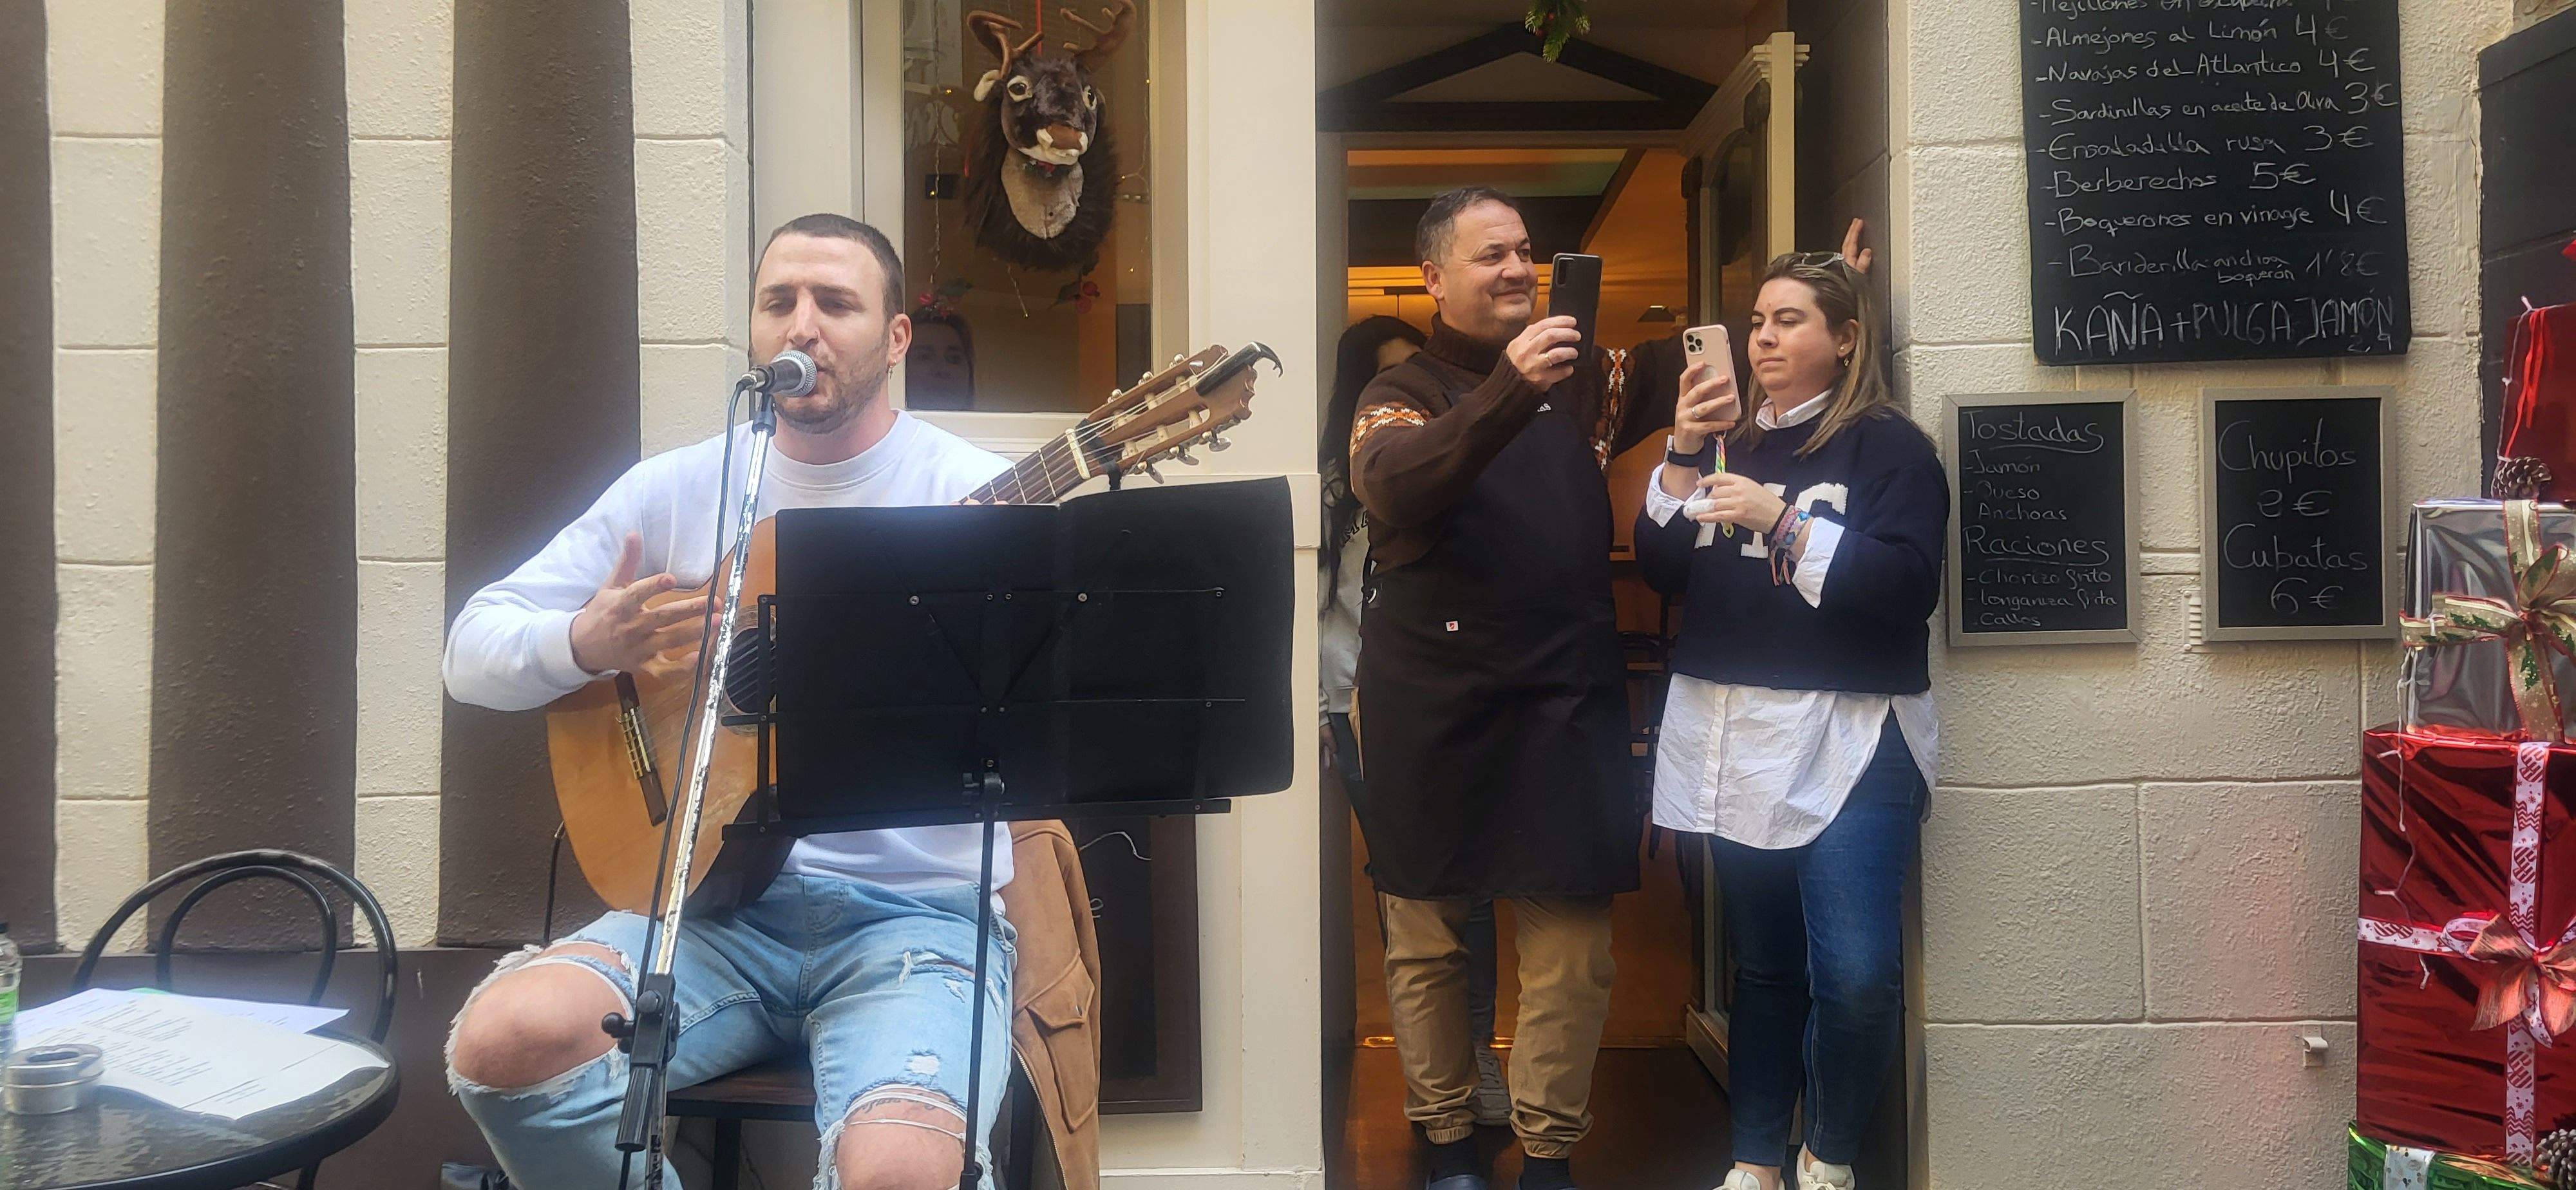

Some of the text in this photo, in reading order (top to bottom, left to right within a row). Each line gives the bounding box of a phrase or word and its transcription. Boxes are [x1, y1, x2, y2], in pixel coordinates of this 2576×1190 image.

[2168, 25, 2196, 43] al
[2208, 18, 2277, 42] Limón
[2145, 58, 2194, 77] del
[2197, 48, 2301, 77] Atlantico
[2182, 104, 2206, 118] en
[2211, 91, 2268, 111] aceite
[2268, 92, 2296, 111] de
[2226, 135, 2286, 154] rusa
[2204, 212, 2233, 226] en
[2240, 204, 2315, 229] vinagre
[1962, 410, 2104, 452] Tostadas
[2219, 417, 2357, 484] Chupitos
[1978, 502, 2068, 521] Anchoas
[1962, 525, 2110, 565] Raciones
[2224, 523, 2368, 571] Cubatas
[2065, 567, 2112, 589] frito
